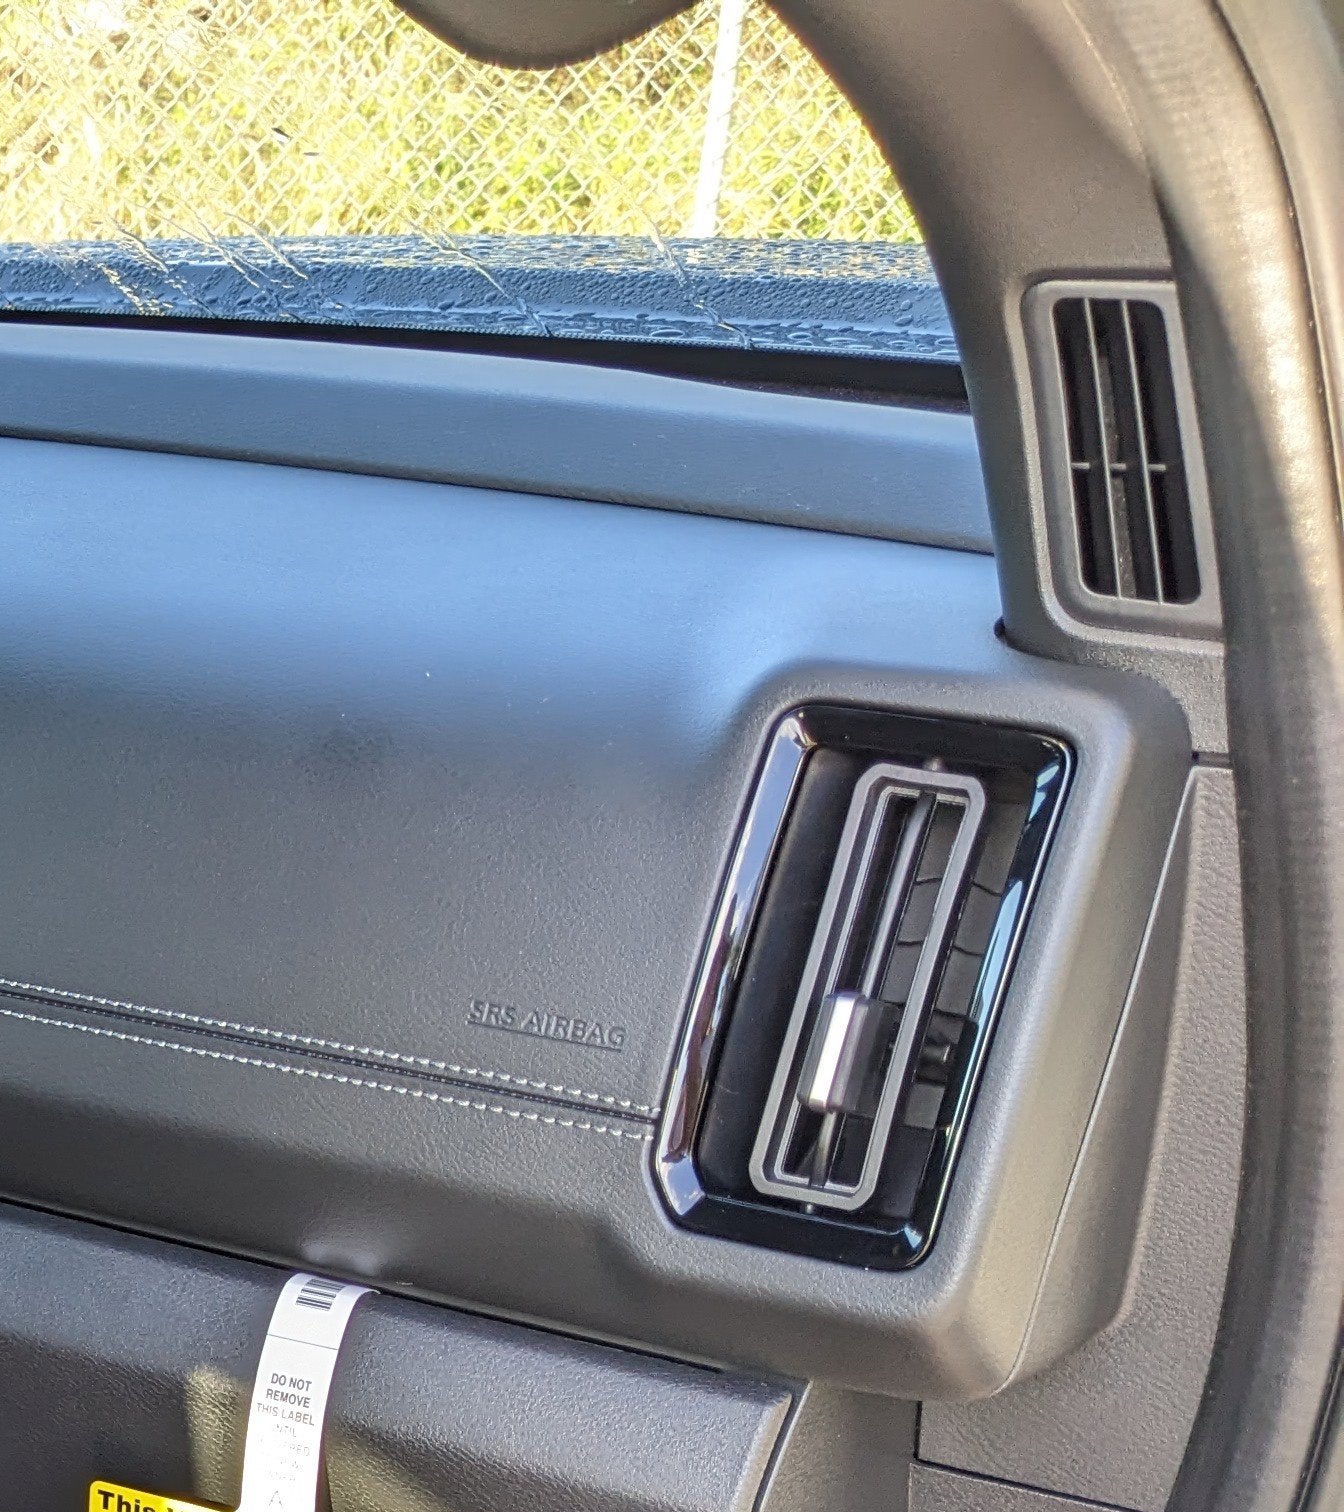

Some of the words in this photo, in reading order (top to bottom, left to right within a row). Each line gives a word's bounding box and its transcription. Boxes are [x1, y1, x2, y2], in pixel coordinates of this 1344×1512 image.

[466, 1000, 516, 1027] SRS
[520, 1009, 627, 1047] AIRBAG
[270, 1373, 287, 1386] DO
[288, 1377, 313, 1392] NOT
[265, 1388, 311, 1409] REMOVE
[256, 1402, 279, 1417] THIS
[281, 1409, 315, 1427] LABEL
